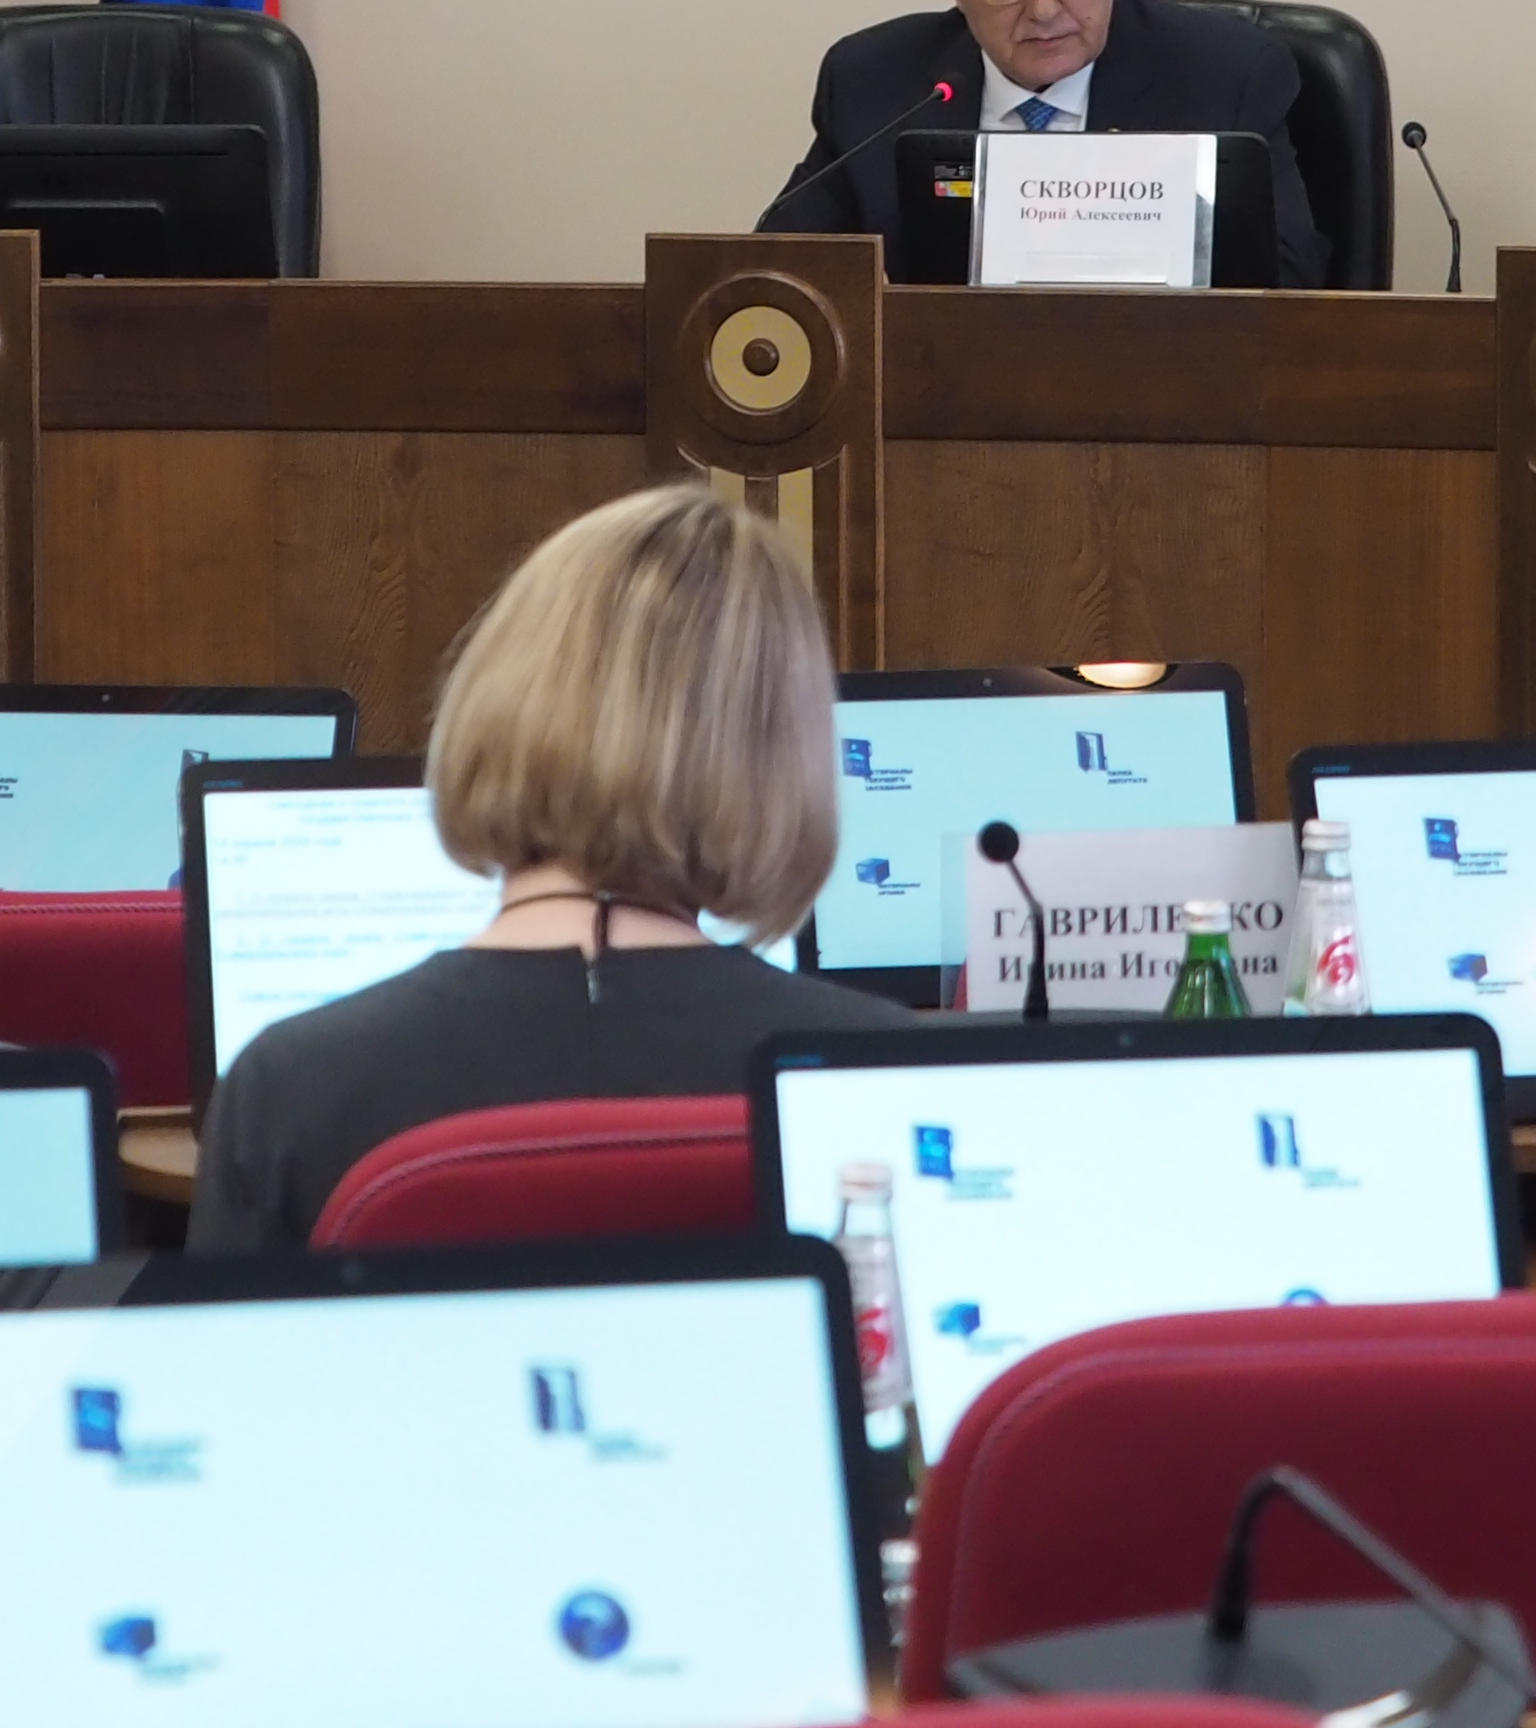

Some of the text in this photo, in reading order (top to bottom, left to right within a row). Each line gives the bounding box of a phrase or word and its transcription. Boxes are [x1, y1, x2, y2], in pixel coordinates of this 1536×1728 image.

[1019, 179, 1164, 202] СКВОРЦОВ
[1019, 206, 1161, 222] Юрий Алексеевич
[993, 902, 1283, 938] ГВРИЛЕКО
[998, 952, 1278, 982] Иина Игона
